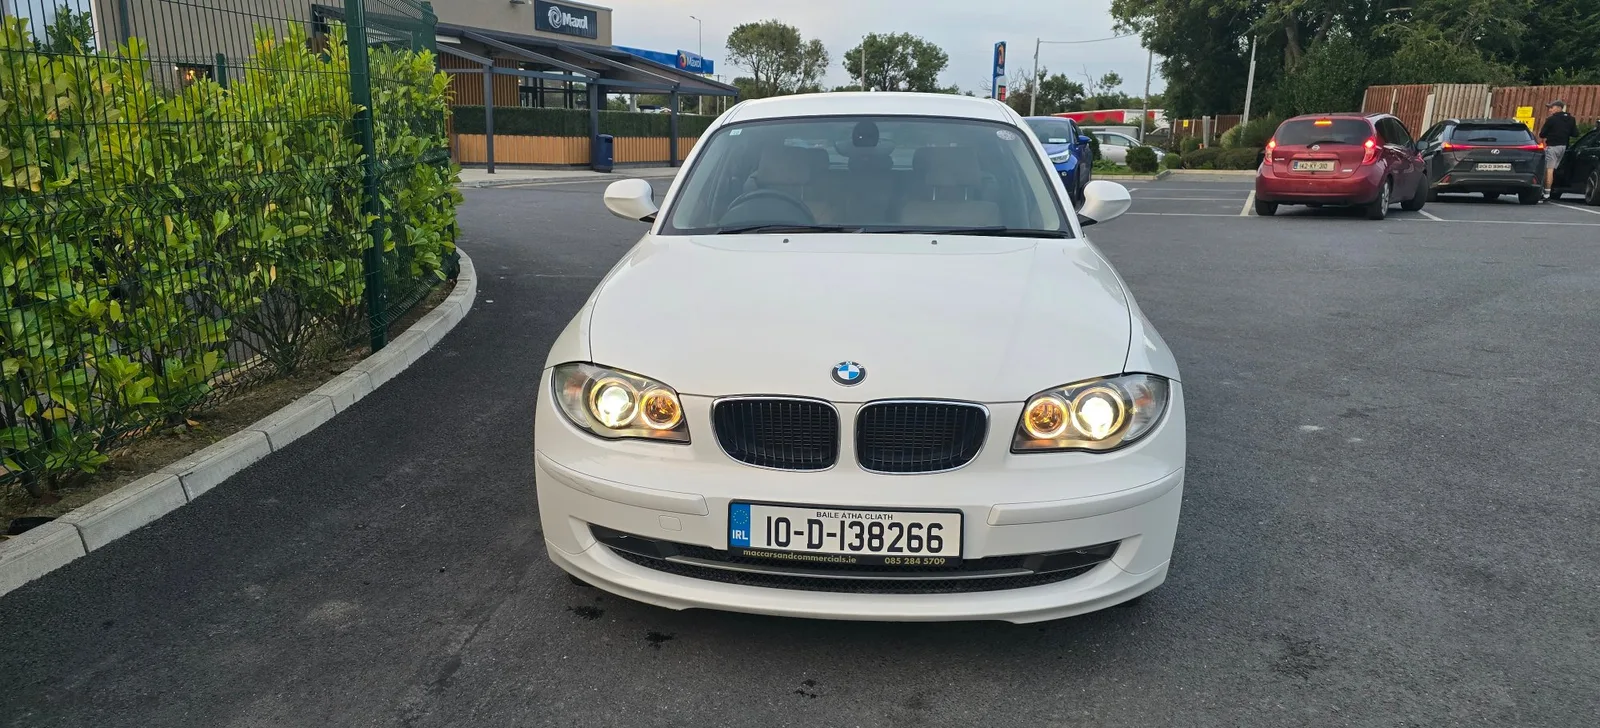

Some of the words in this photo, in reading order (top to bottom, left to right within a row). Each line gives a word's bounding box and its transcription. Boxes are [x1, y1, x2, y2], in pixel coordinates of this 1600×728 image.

[562, 12, 588, 29] Maxol
[687, 56, 702, 68] Maxol
[816, 511, 839, 519] BAILE
[864, 513, 893, 521] CLIATH
[732, 529, 749, 541] IRL
[766, 516, 944, 554] 10-D-138266
[743, 549, 857, 564] maccarsandcommercials.ie
[884, 557, 901, 565] 085
[904, 557, 921, 566] 284
[923, 557, 946, 566] 5709
